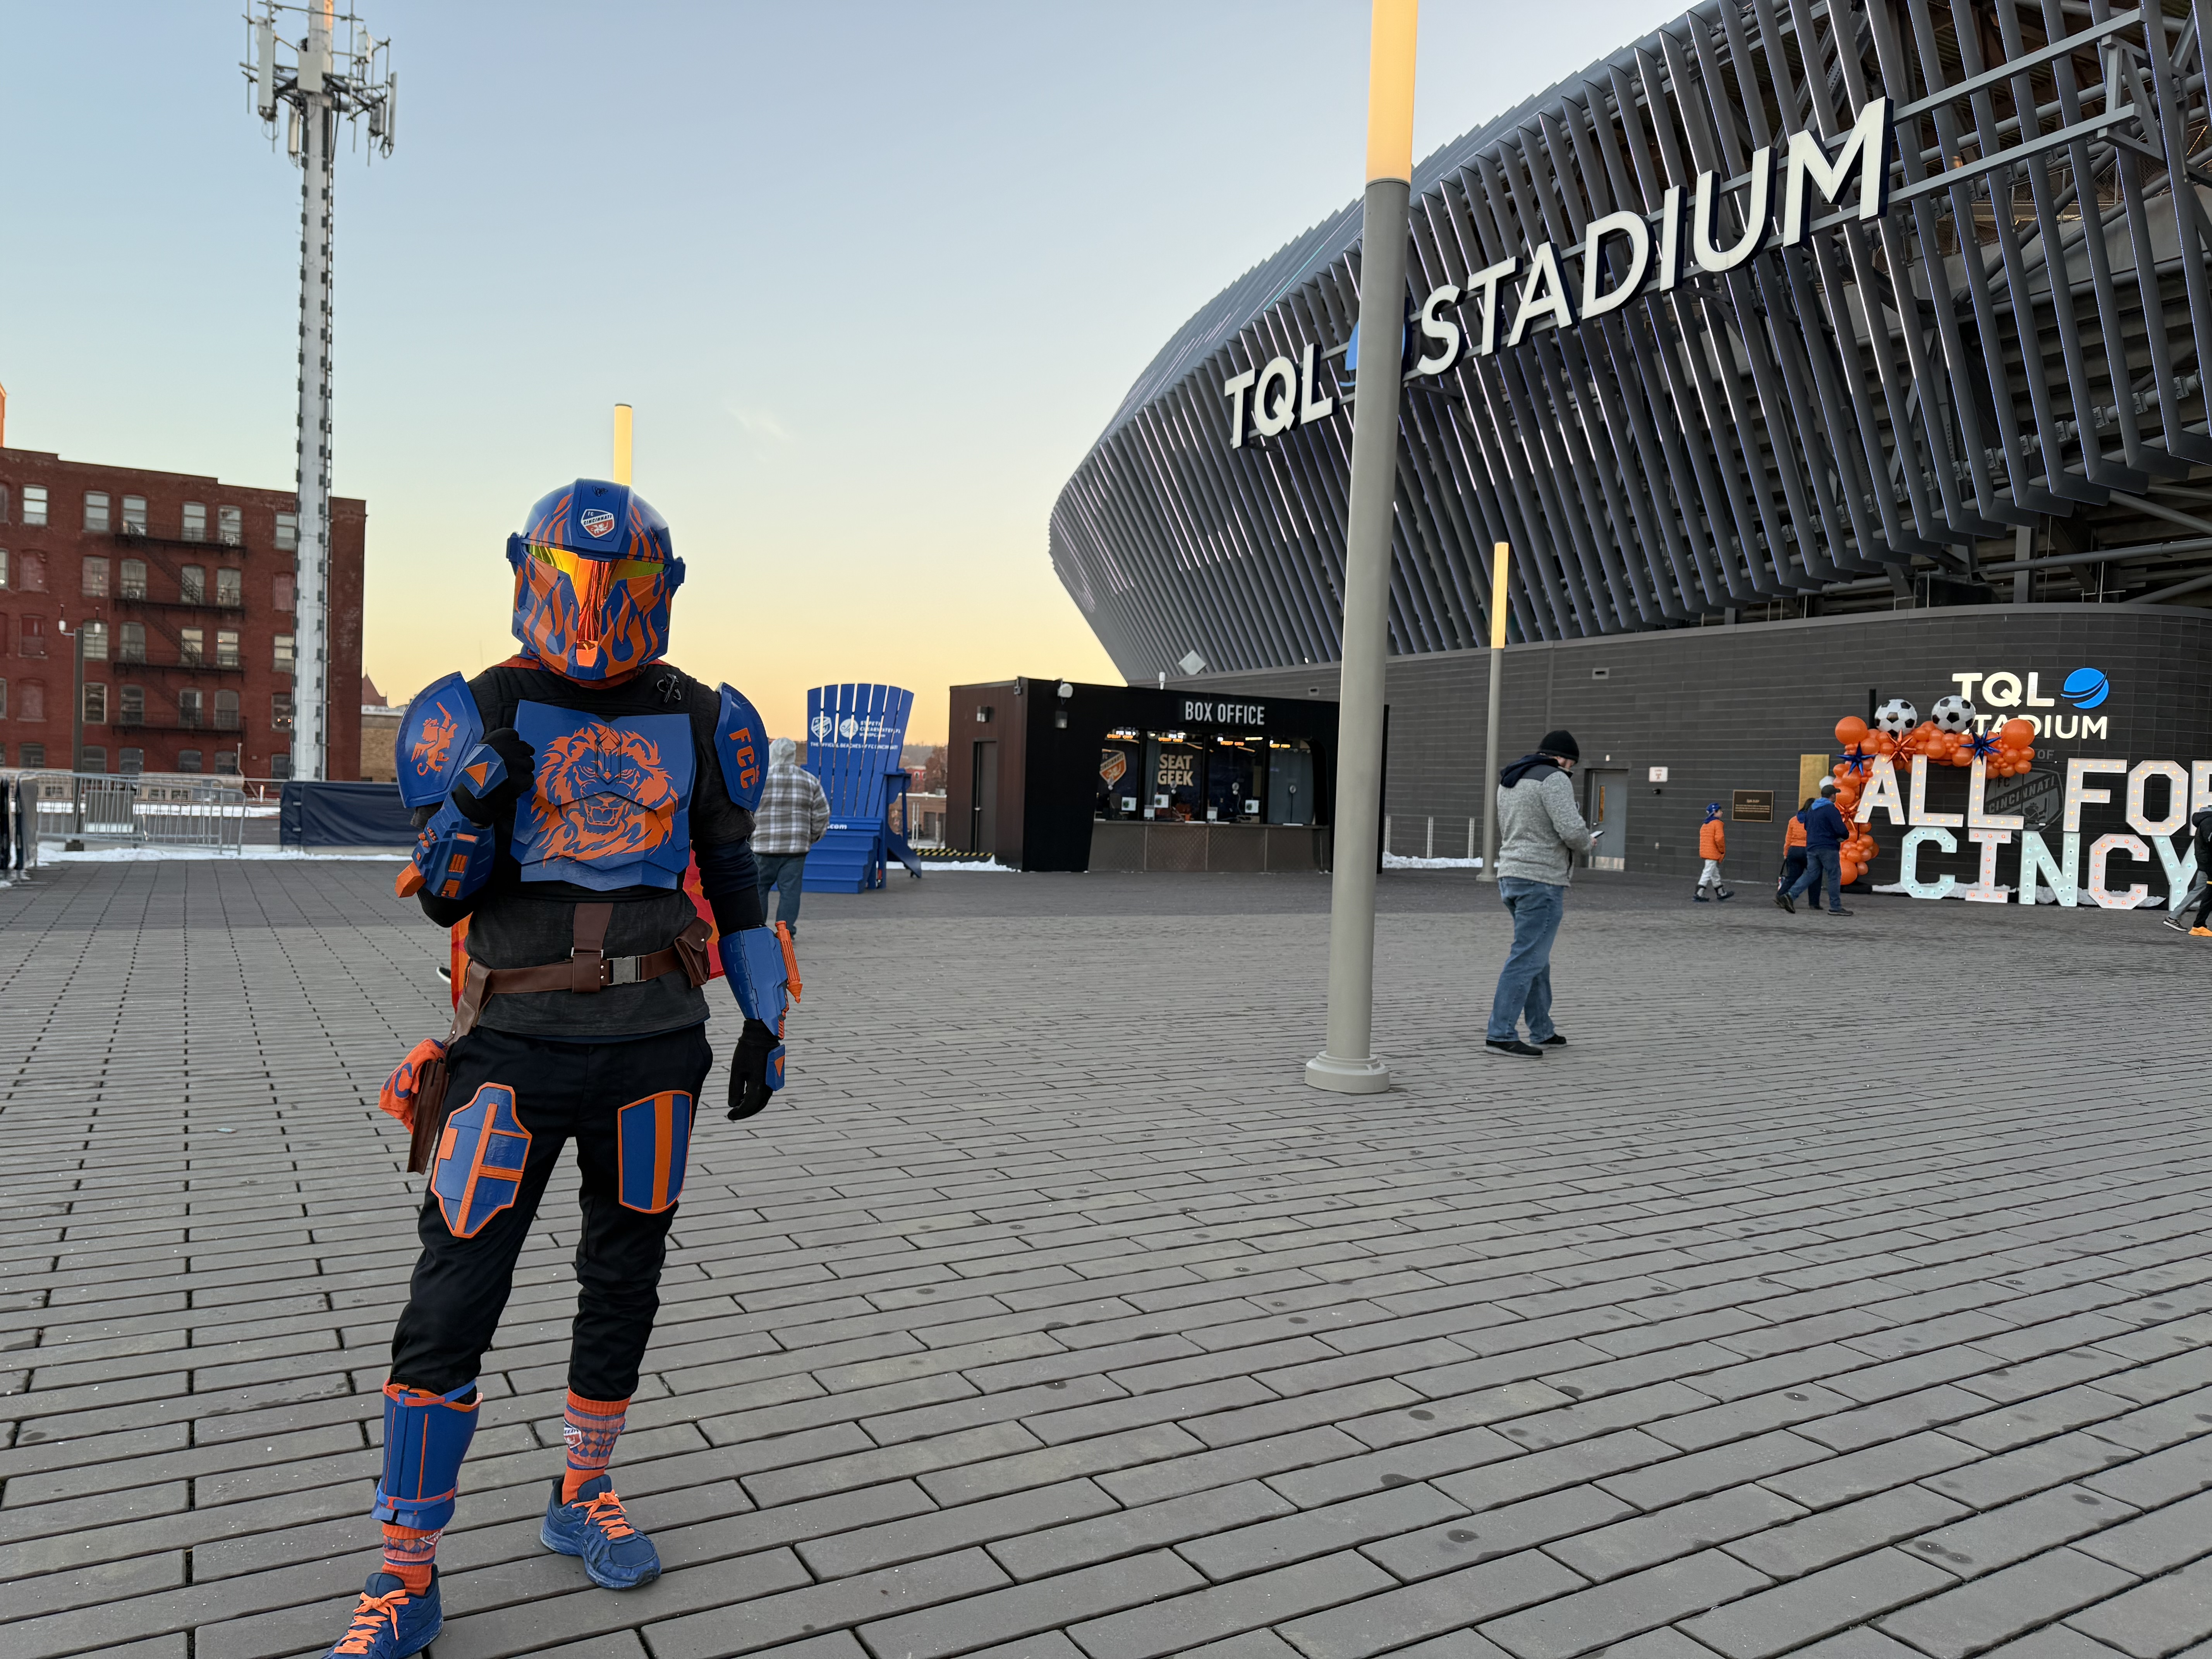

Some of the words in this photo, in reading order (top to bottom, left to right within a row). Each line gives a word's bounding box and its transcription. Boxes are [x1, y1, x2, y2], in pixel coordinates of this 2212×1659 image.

[1224, 343, 1334, 449] TQL
[1417, 96, 1891, 375] STADIUM
[584, 514, 612, 525] CINCINNATI
[1952, 672, 2055, 708] TQL
[1185, 701, 1212, 721] BOX
[1218, 704, 1265, 725] OFFICE
[1962, 714, 2107, 740] TADIUM
[728, 727, 756, 788] FCC
[1159, 754, 1193, 770] SEAT
[2037, 749, 2054, 759] OF
[1158, 770, 1194, 787] GEEK
[1853, 753, 2024, 830] ALL
[1997, 777, 2010, 788] FC
[1989, 775, 2055, 814] CINCINNATI
[1900, 826, 2198, 911] CINCY
